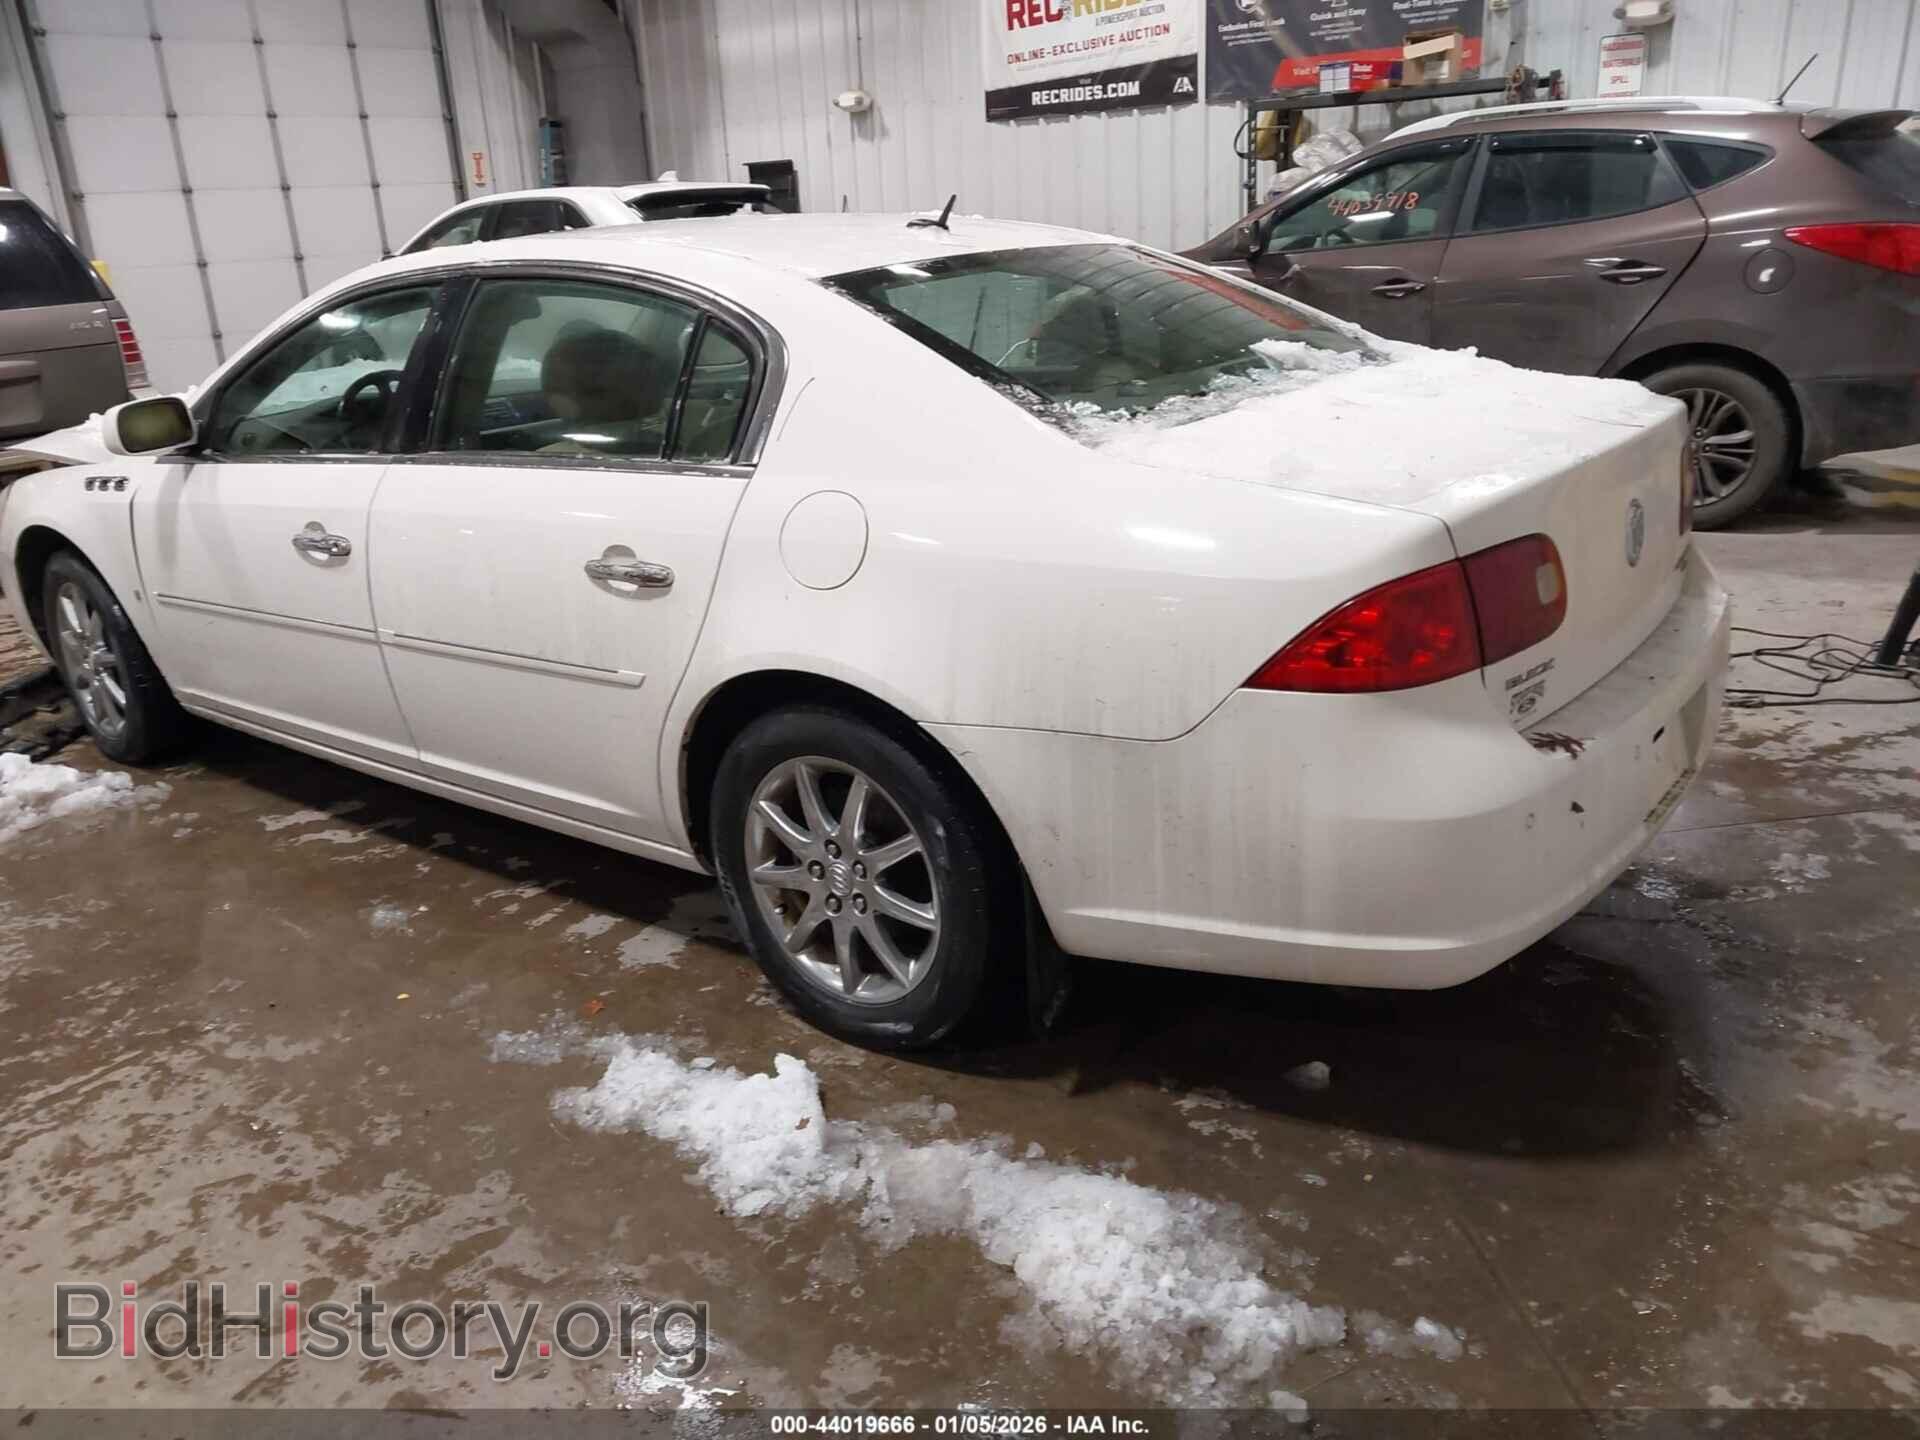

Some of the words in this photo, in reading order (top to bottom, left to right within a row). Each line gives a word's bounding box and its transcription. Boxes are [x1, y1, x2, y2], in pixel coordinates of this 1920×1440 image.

[1007, 0, 1064, 31] REC
[1218, 23, 1248, 33] Exclusive
[1249, 19, 1266, 28] First
[1310, 12, 1332, 21] Quick
[1334, 10, 1347, 18] and
[1349, 8, 1367, 17] Easy
[1007, 34, 1115, 65] ONLINE-EXCLUSIVE
[1119, 23, 1171, 43] AUCTION
[1031, 80, 1140, 106] RECRIDES.COM
